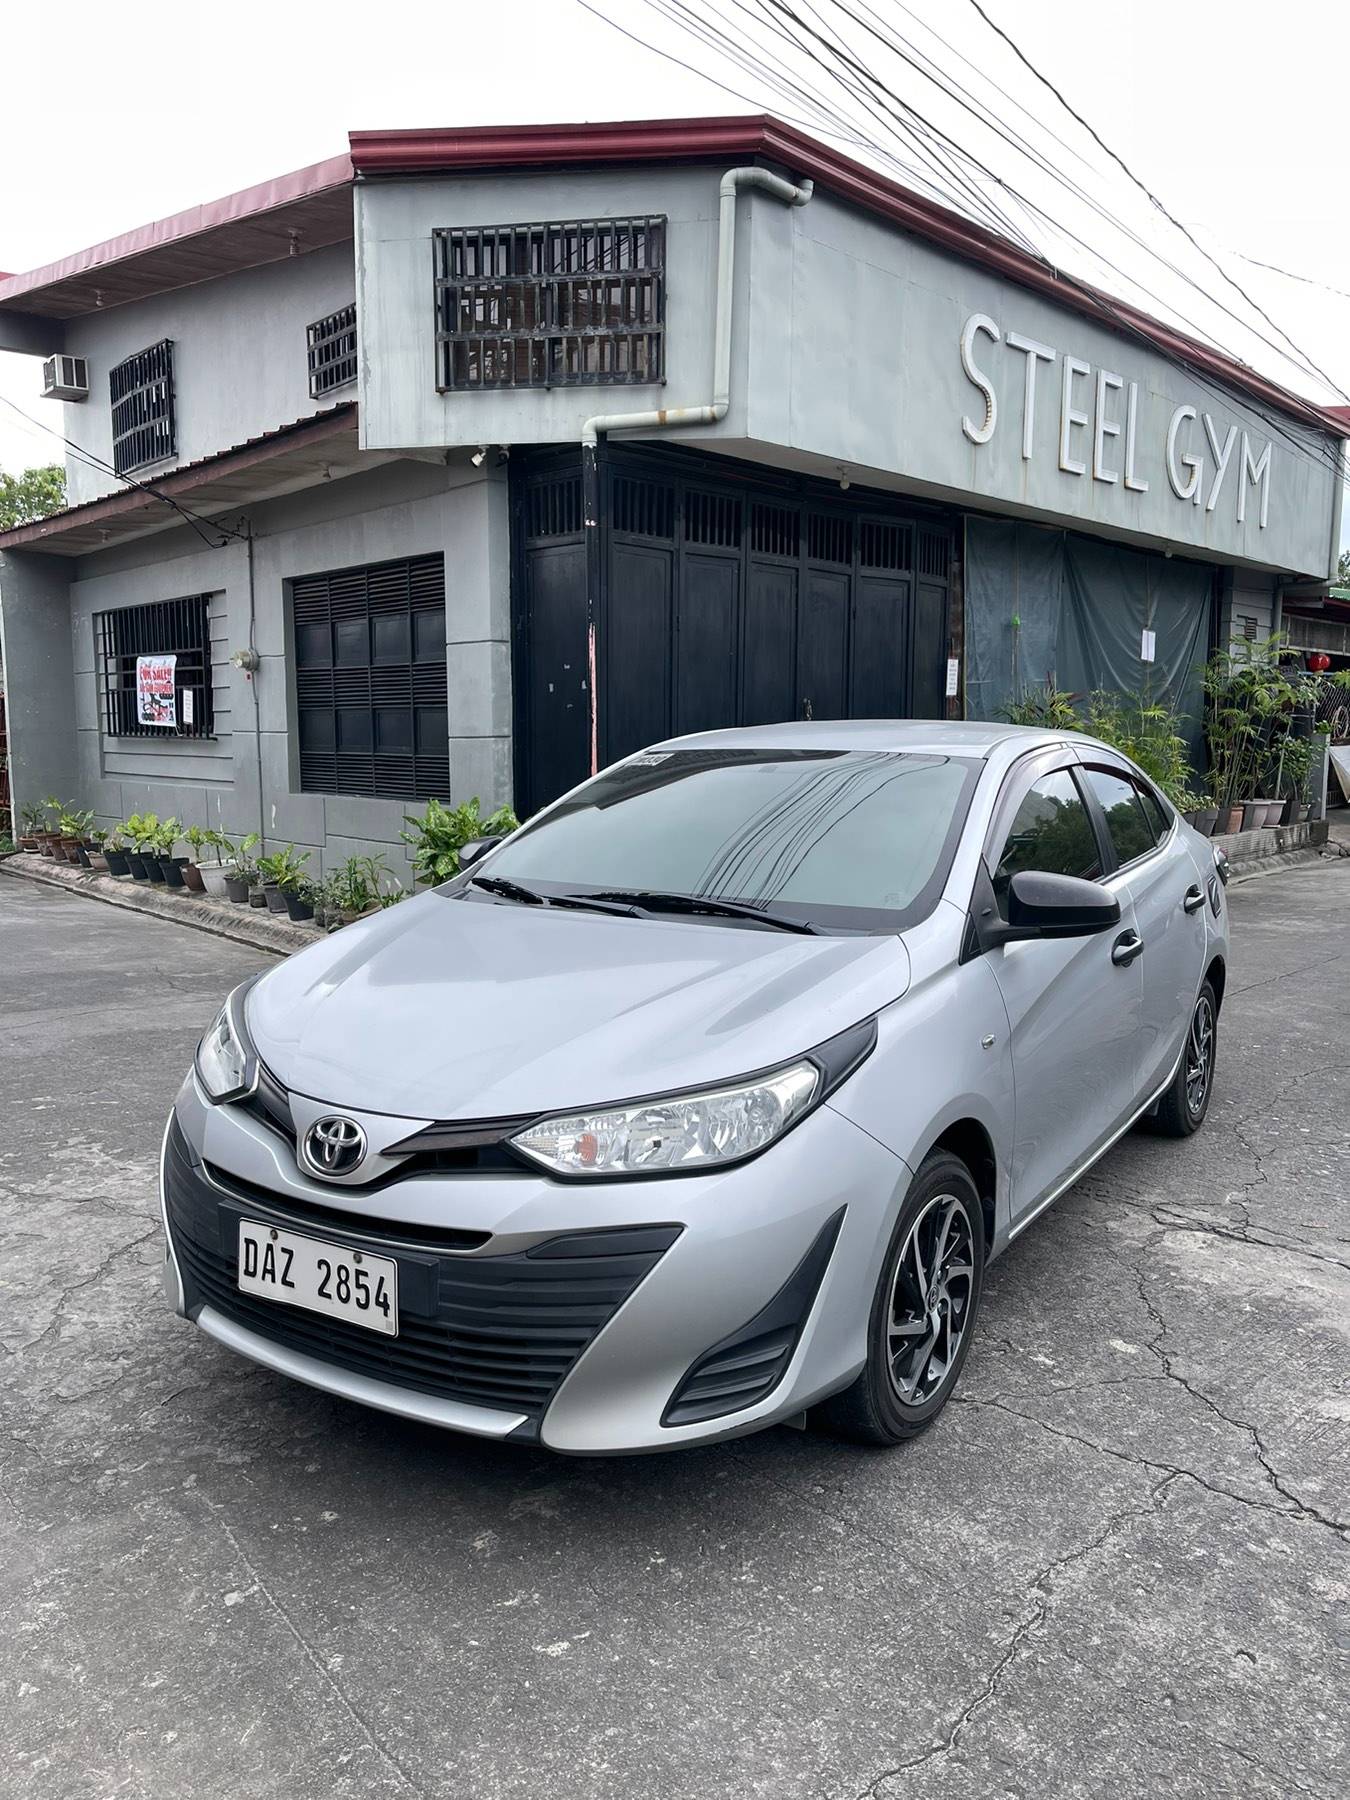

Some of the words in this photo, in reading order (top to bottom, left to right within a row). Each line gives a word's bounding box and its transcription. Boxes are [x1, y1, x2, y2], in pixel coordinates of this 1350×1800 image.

[960, 313, 1149, 492] STEEL
[1166, 404, 1272, 528] GYM
[244, 1237, 295, 1289] DAZ
[317, 1258, 390, 1318] 2854
